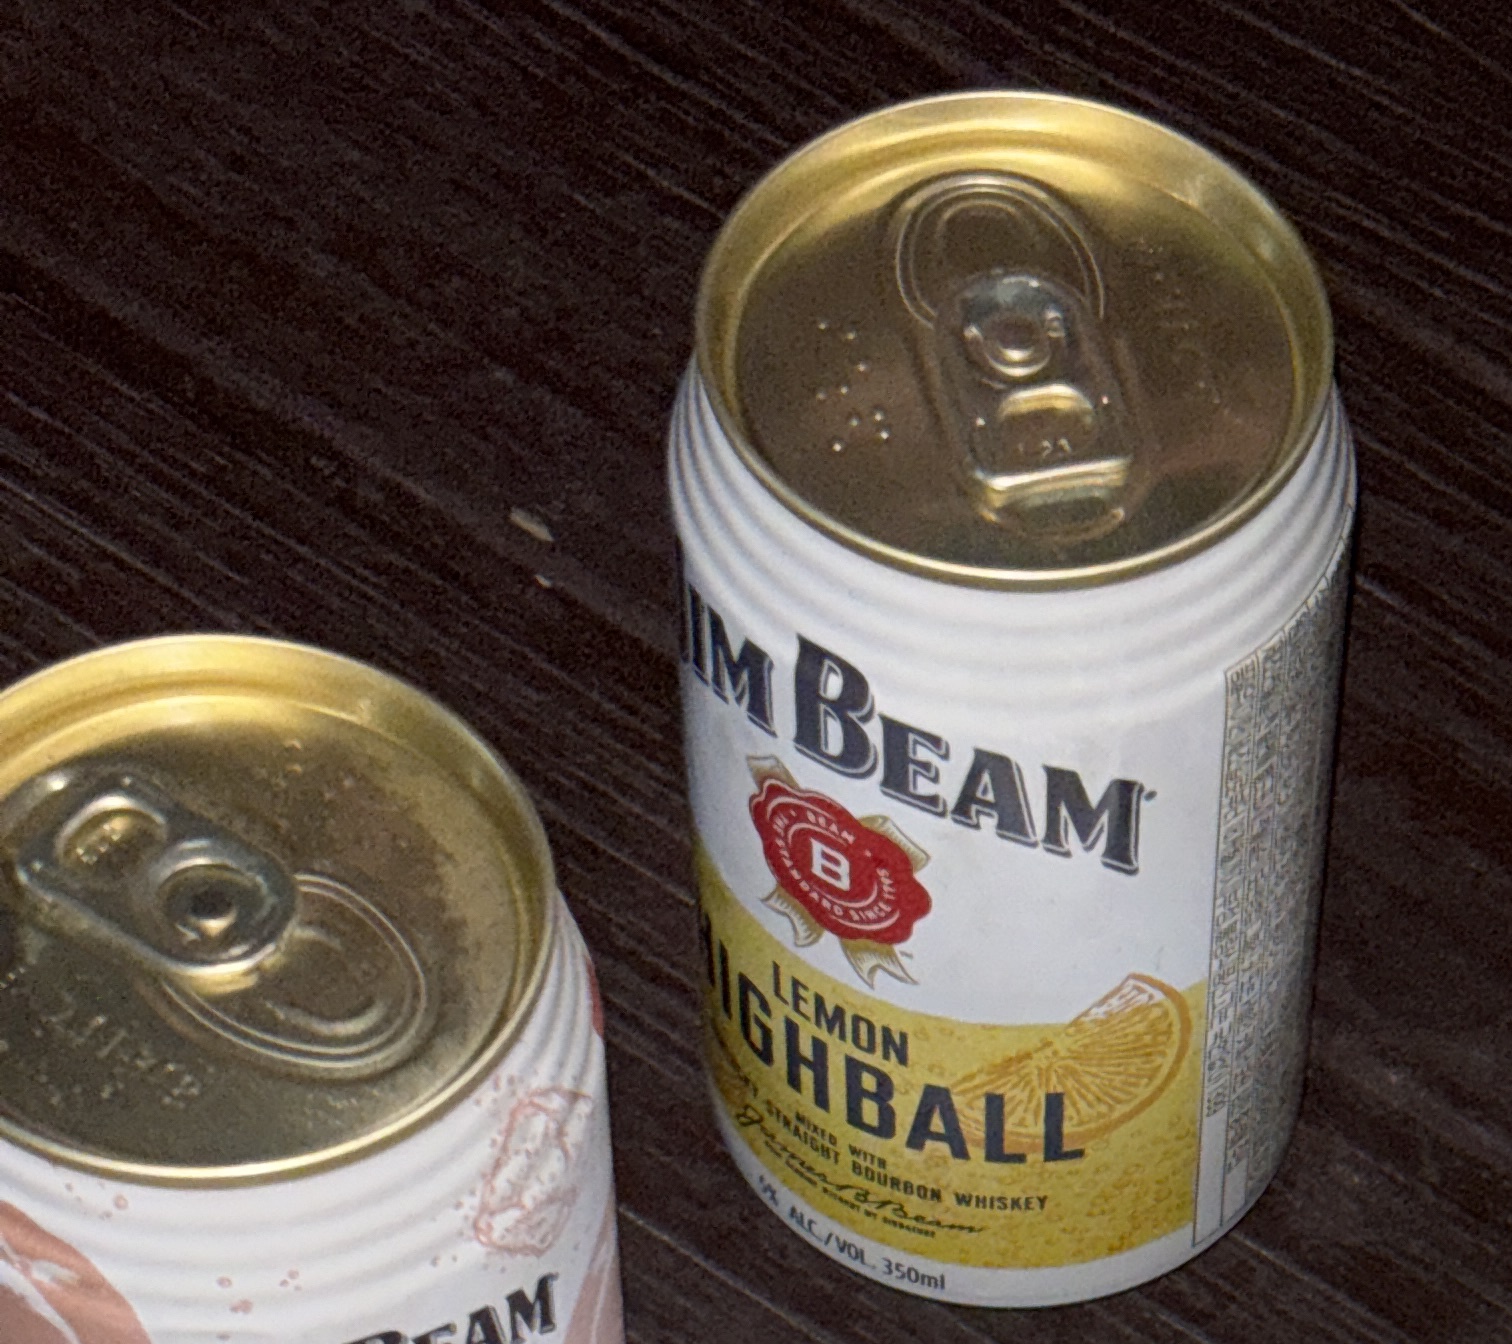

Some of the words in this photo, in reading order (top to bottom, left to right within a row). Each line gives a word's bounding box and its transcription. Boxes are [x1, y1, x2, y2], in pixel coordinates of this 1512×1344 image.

[681, 580, 778, 738] IM
[794, 632, 1140, 877] BEAM
[810, 837, 850, 892] B
[773, 960, 908, 1067] LEMON
[766, 1099, 841, 1166] STRAIGHT
[852, 1158, 942, 1203] BOURBON
[953, 1190, 1049, 1212] WHISKEY
[795, 1110, 838, 1148] MIXED
[848, 1143, 887, 1171] WITH
[882, 1257, 946, 1291] 350ml
